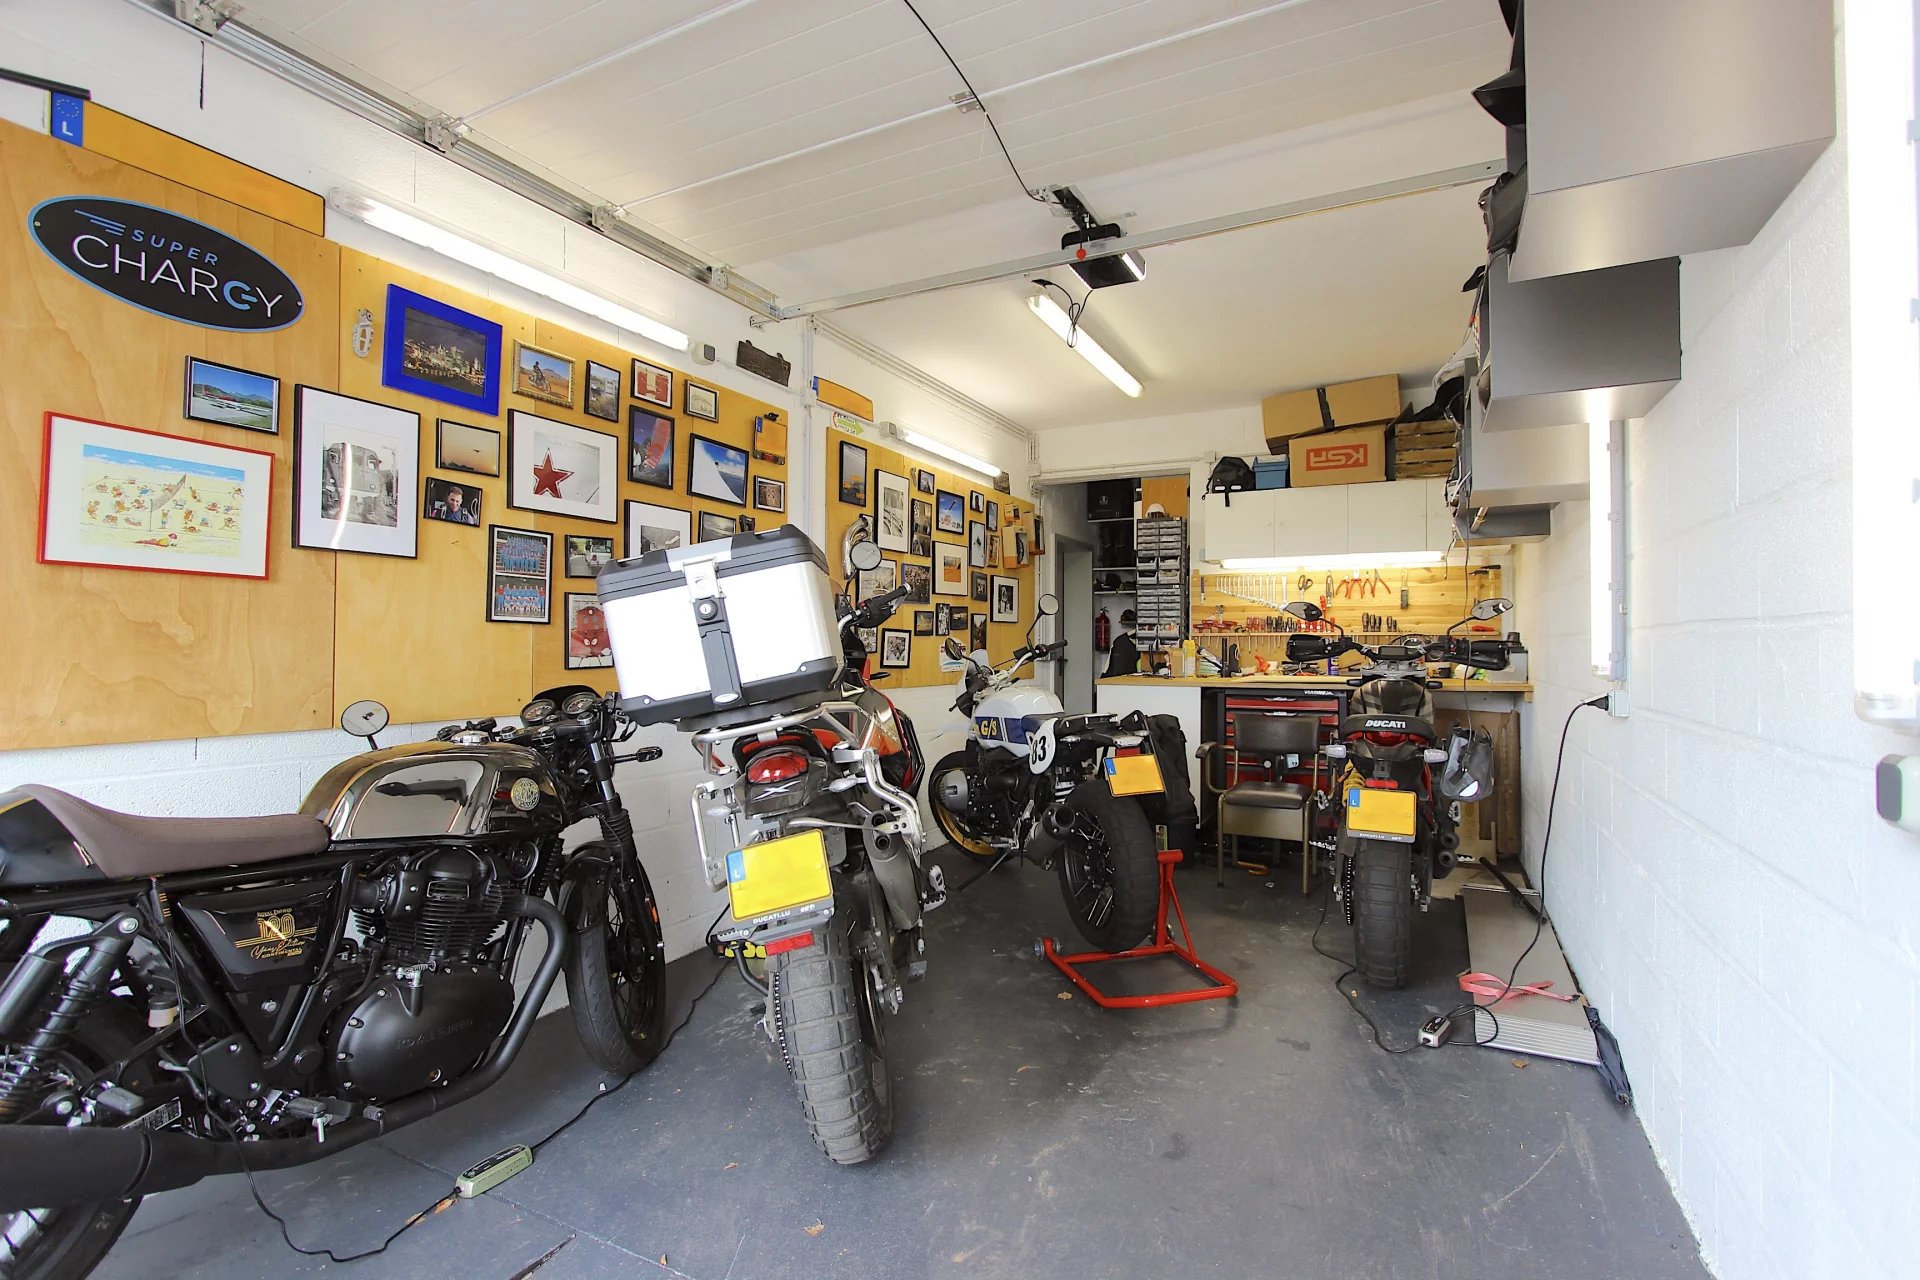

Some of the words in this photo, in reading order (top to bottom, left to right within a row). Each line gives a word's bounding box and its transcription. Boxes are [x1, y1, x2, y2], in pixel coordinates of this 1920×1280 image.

[62, 121, 74, 136] L
[132, 229, 219, 265] SUPER
[72, 235, 283, 317] CHARGY
[980, 718, 997, 739] G/S
[1365, 719, 1406, 729] DUCATI
[1031, 735, 1046, 765] 83
[752, 911, 791, 925] DUCATI.LU
